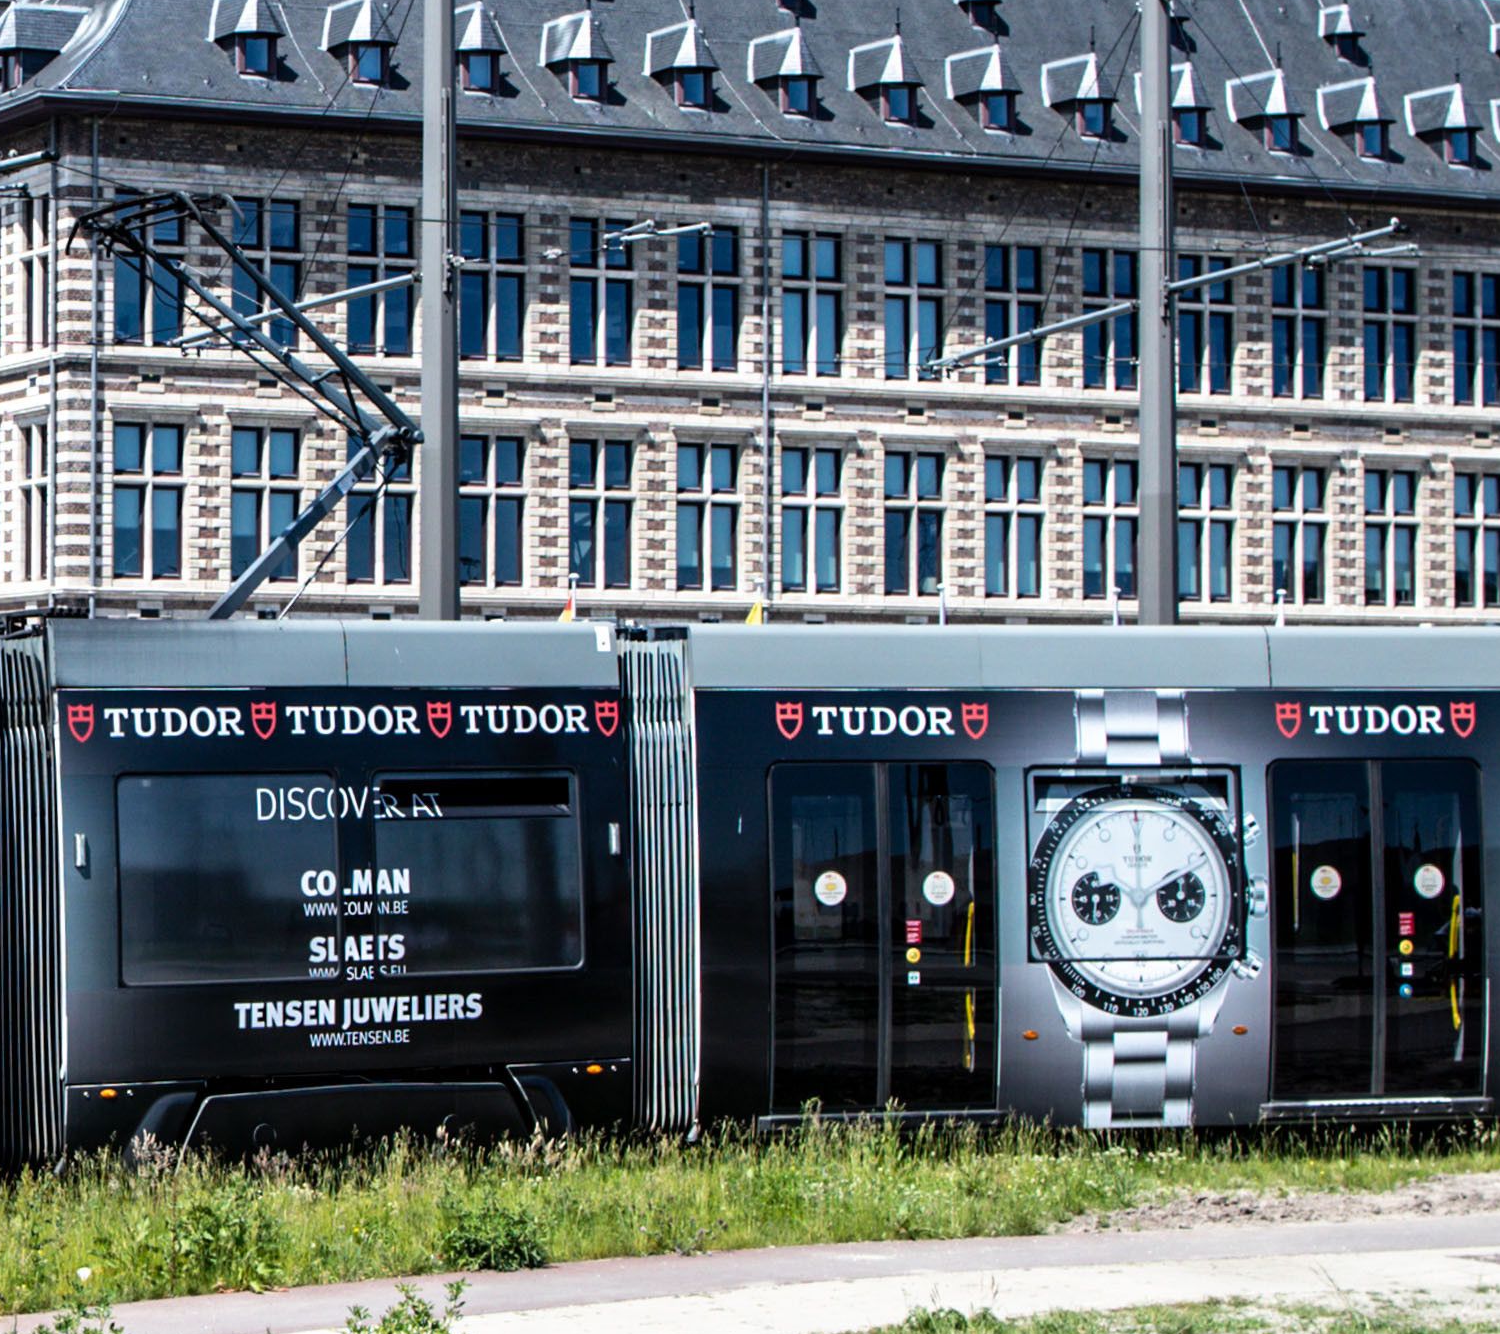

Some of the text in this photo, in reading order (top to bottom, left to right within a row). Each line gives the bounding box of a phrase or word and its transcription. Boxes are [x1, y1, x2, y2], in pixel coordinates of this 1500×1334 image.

[103, 704, 590, 737] TUDOR TUDOR TUDOR
[812, 705, 956, 737] TUDOR
[1309, 704, 1446, 735] TUDOR
[412, 792, 443, 818] AT
[1209, 968, 1224, 984] 160
[1071, 984, 1086, 998] 100
[1196, 981, 1211, 995] 150
[1179, 993, 1195, 1005] 140
[234, 993, 483, 1030] TENSEN JUWELIERS
[1103, 1002, 1119, 1013] 110
[1133, 1007, 1149, 1017] 120
[1158, 1002, 1175, 1013] 130
[309, 1029, 410, 1047] WWW.TENSEN.BE
